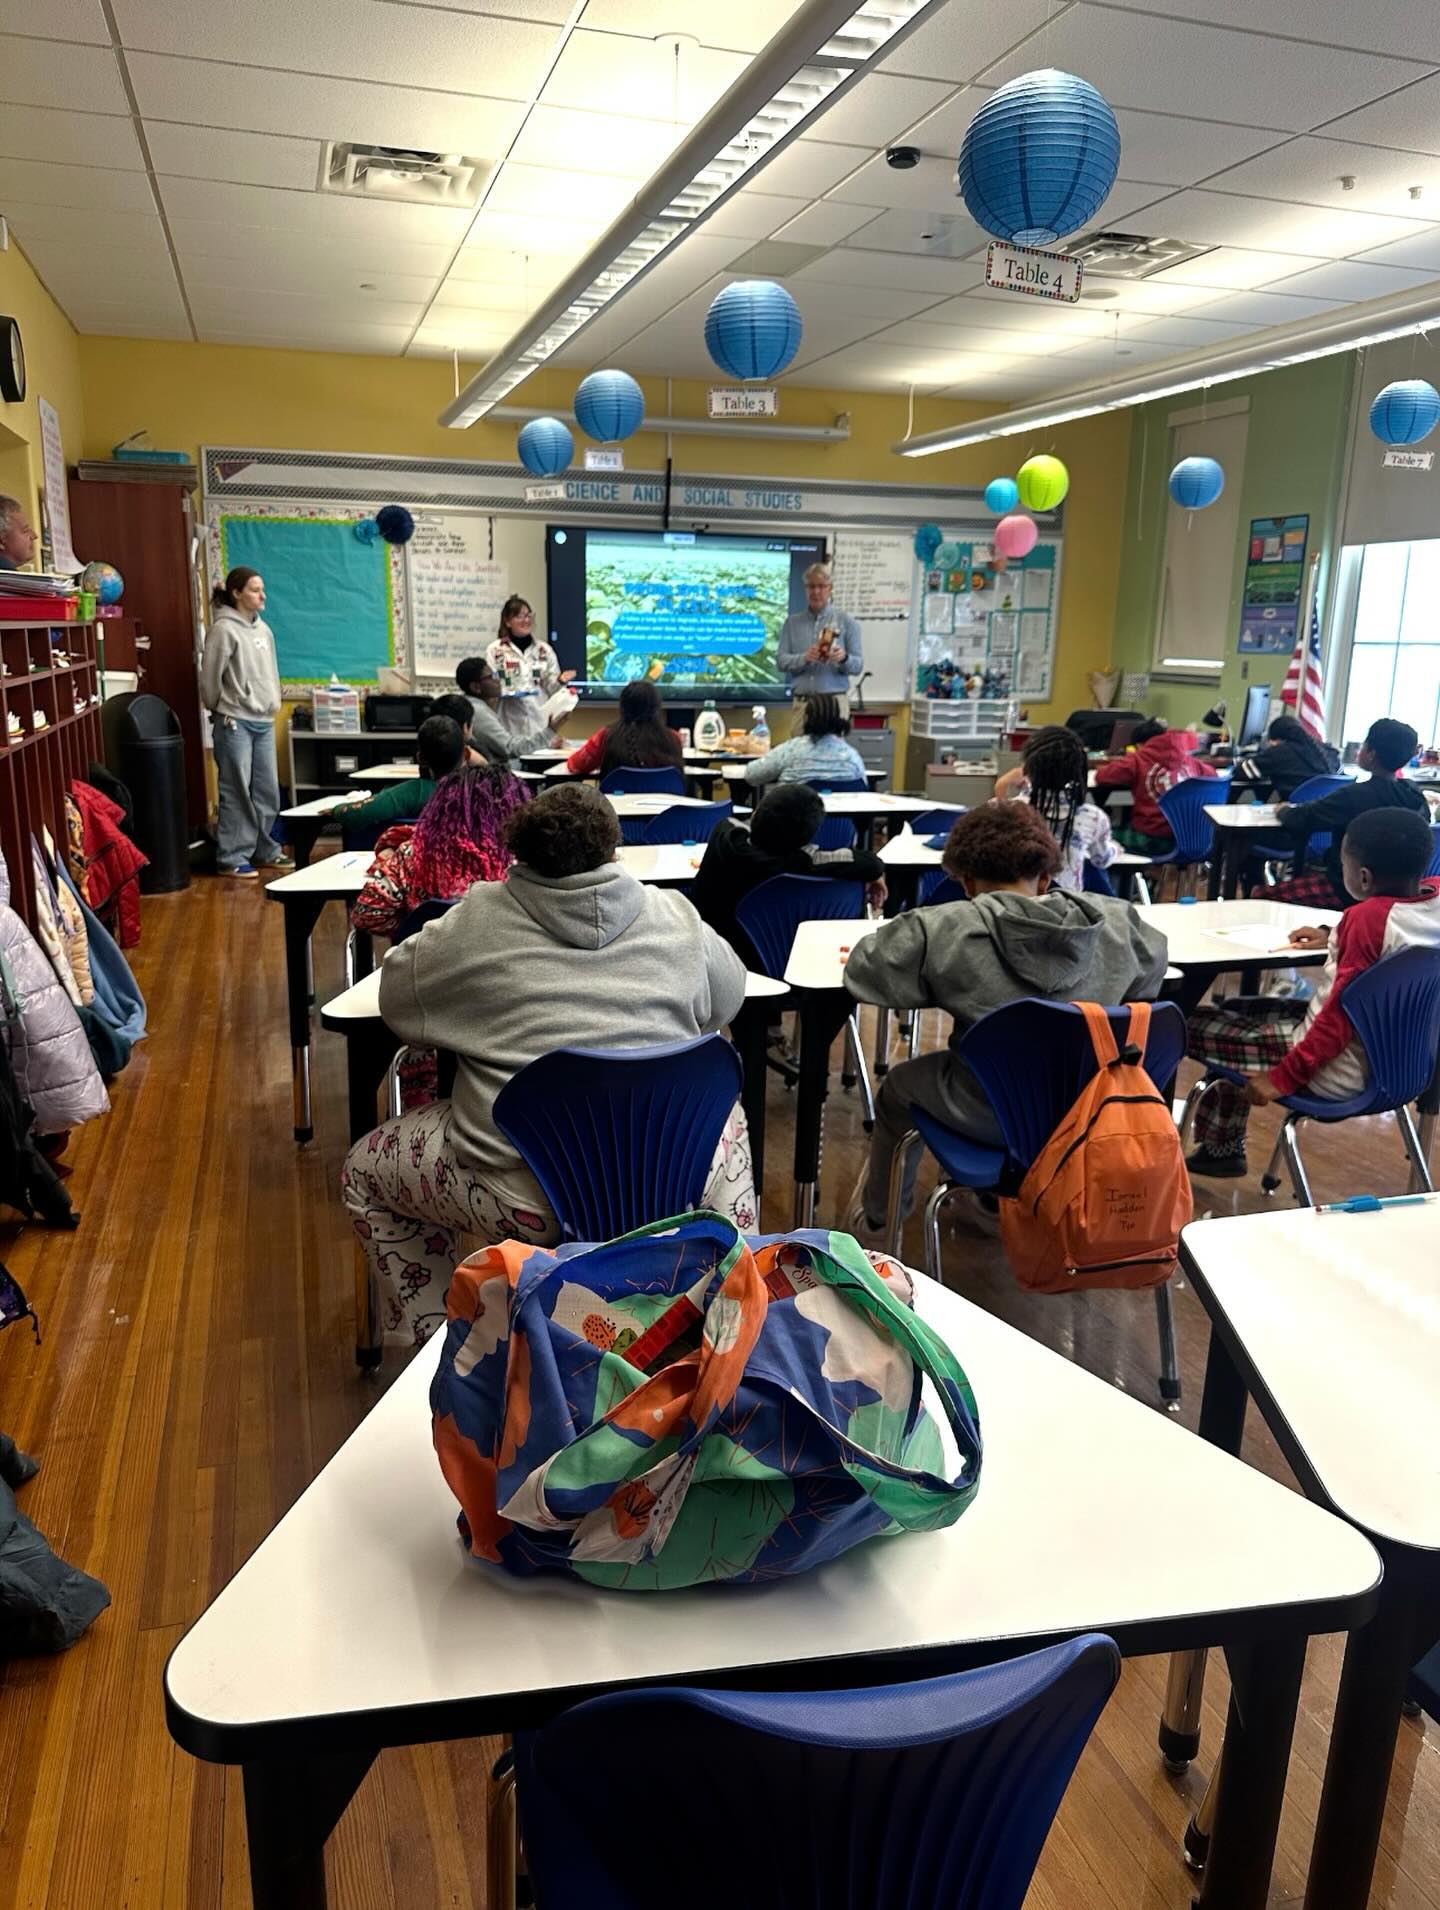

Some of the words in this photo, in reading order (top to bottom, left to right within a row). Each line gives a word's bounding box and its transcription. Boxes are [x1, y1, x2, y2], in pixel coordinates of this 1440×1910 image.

[1004, 258, 1049, 285] Table
[1053, 274, 1064, 292] 4
[722, 396, 756, 410] Table
[758, 400, 766, 412] 3
[1391, 454, 1416, 465] Table
[565, 481, 620, 501] CIENCE
[632, 485, 665, 503] AND
[683, 488, 734, 507] SOCIAL
[745, 491, 803, 511] STUDIES
